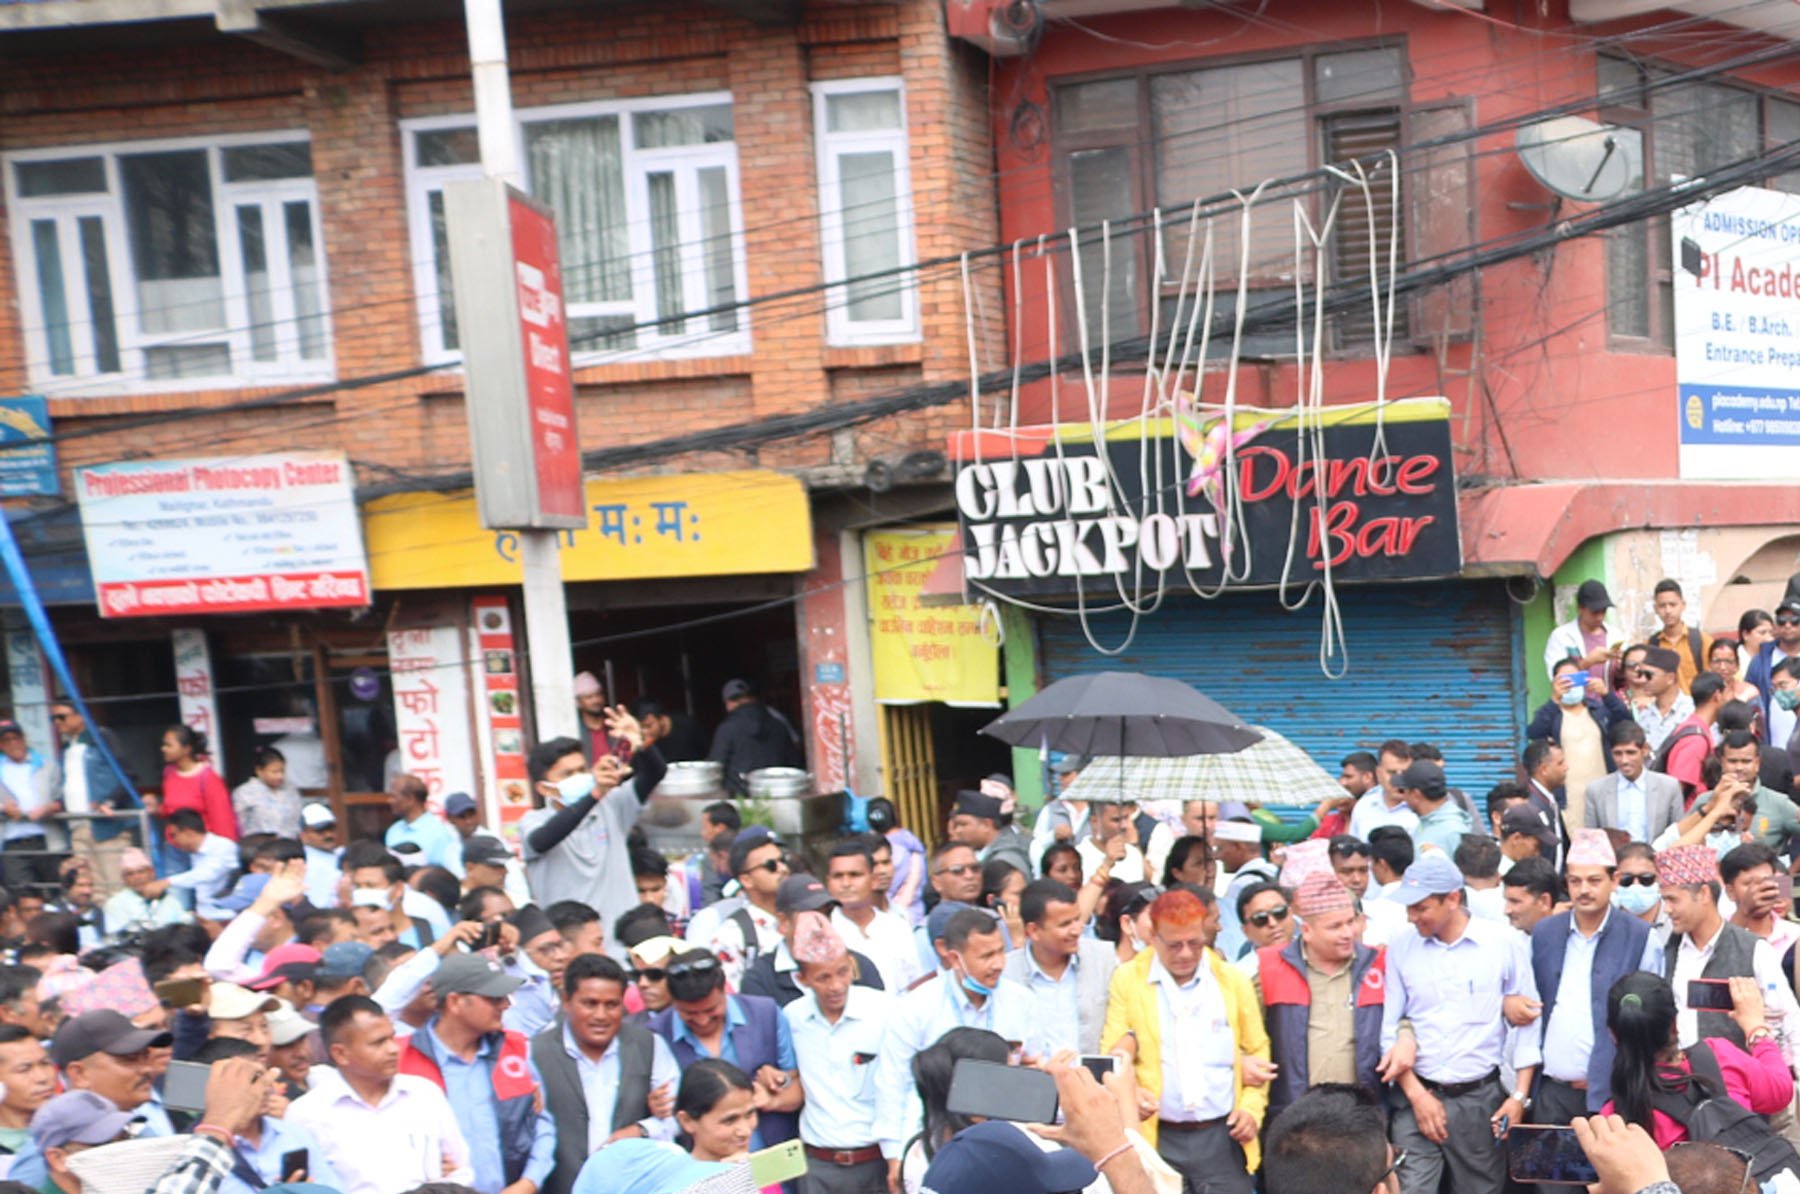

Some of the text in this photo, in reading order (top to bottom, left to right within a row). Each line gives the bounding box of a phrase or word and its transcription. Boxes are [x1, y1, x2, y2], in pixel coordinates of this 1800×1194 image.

[1703, 212, 1777, 241] ADMISSION
[1696, 251, 1720, 291] PI
[1711, 312, 1736, 333] B.E.
[1748, 316, 1793, 337] B.Arch.
[1705, 342, 1764, 365] Entrance
[86, 461, 341, 496] Professional Photocopy Center
[955, 455, 1112, 521] CLUB
[1237, 444, 1442, 502] Dance
[964, 512, 1220, 580] JACKPOT
[1307, 500, 1435, 571] Bar
